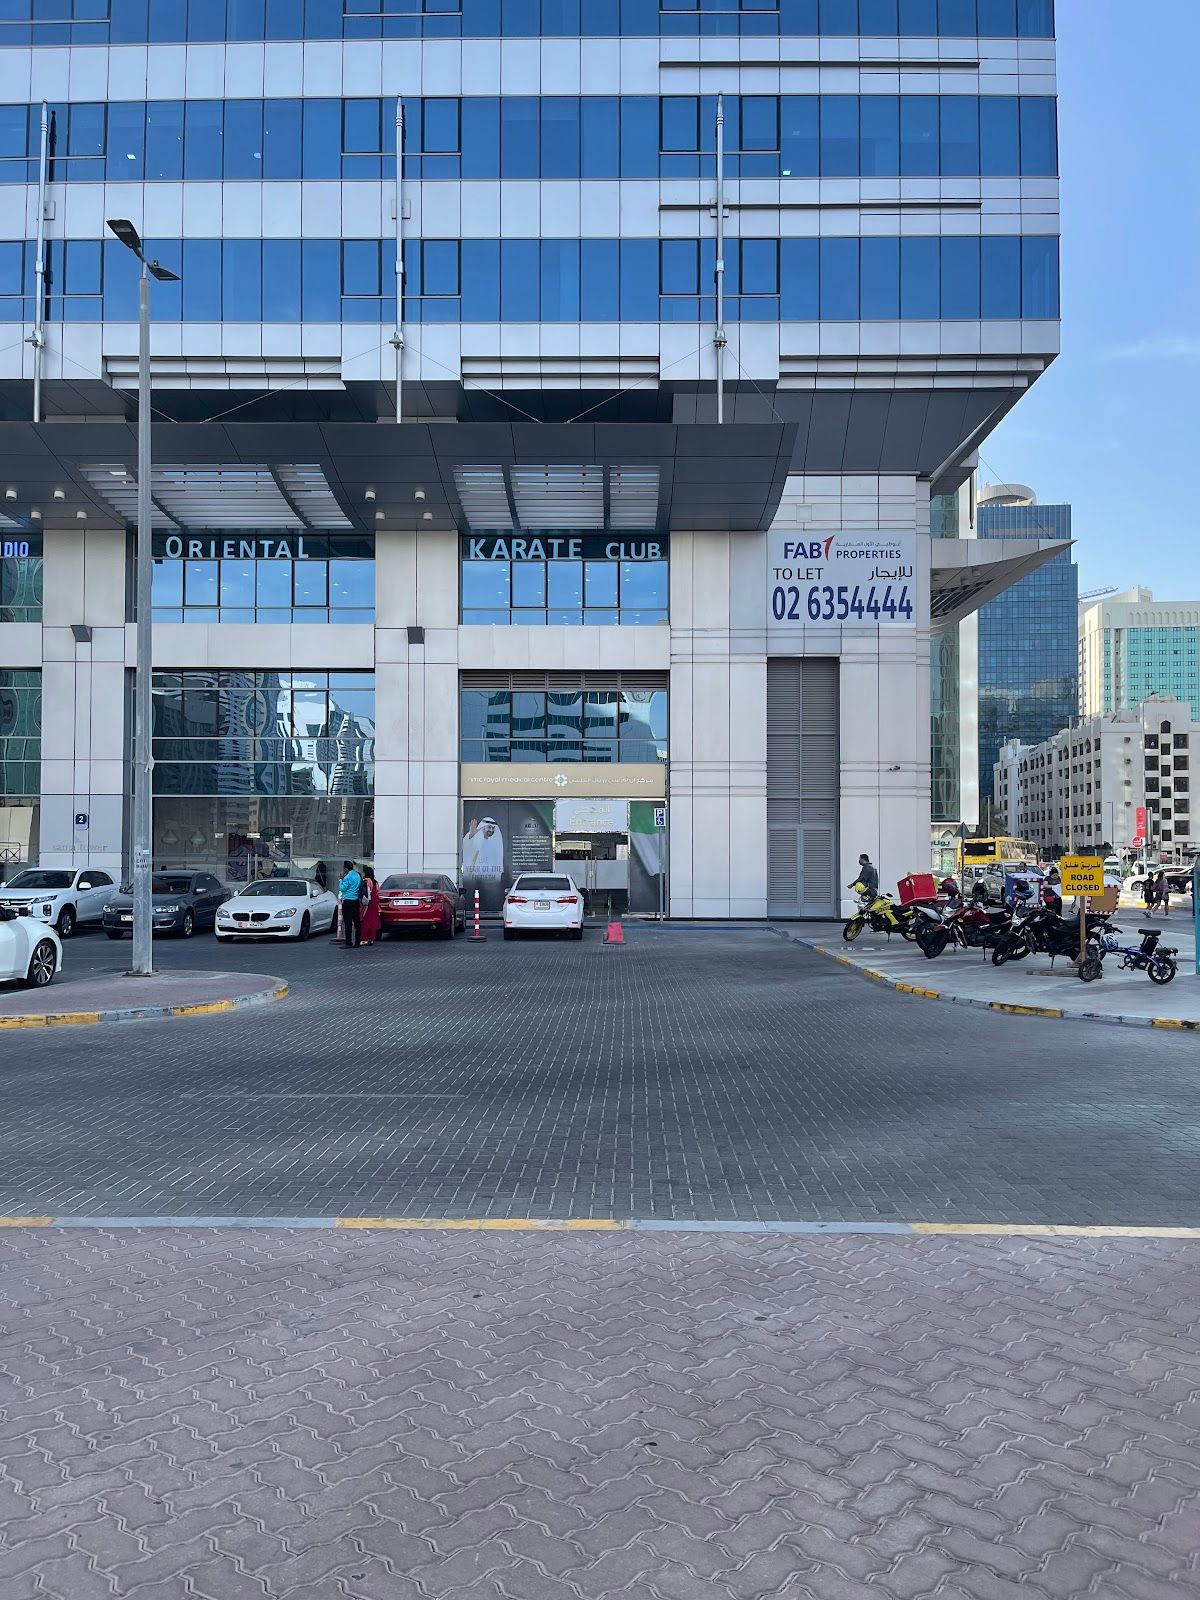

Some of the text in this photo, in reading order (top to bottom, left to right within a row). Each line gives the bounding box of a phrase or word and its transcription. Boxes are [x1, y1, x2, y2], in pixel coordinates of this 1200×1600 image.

[0, 541, 29, 558] DIO
[165, 535, 662, 560] ORIENTAL KARATE CLUB
[783, 541, 822, 560] FAB
[836, 550, 902, 559] PROPERTIES
[773, 568, 824, 580] TO LET
[868, 565, 913, 581] للإيجار
[772, 585, 913, 620] 02 6354444
[78, 815, 84, 823] 2
[656, 808, 664, 817] P
[1080, 861, 1101, 871] طريق
